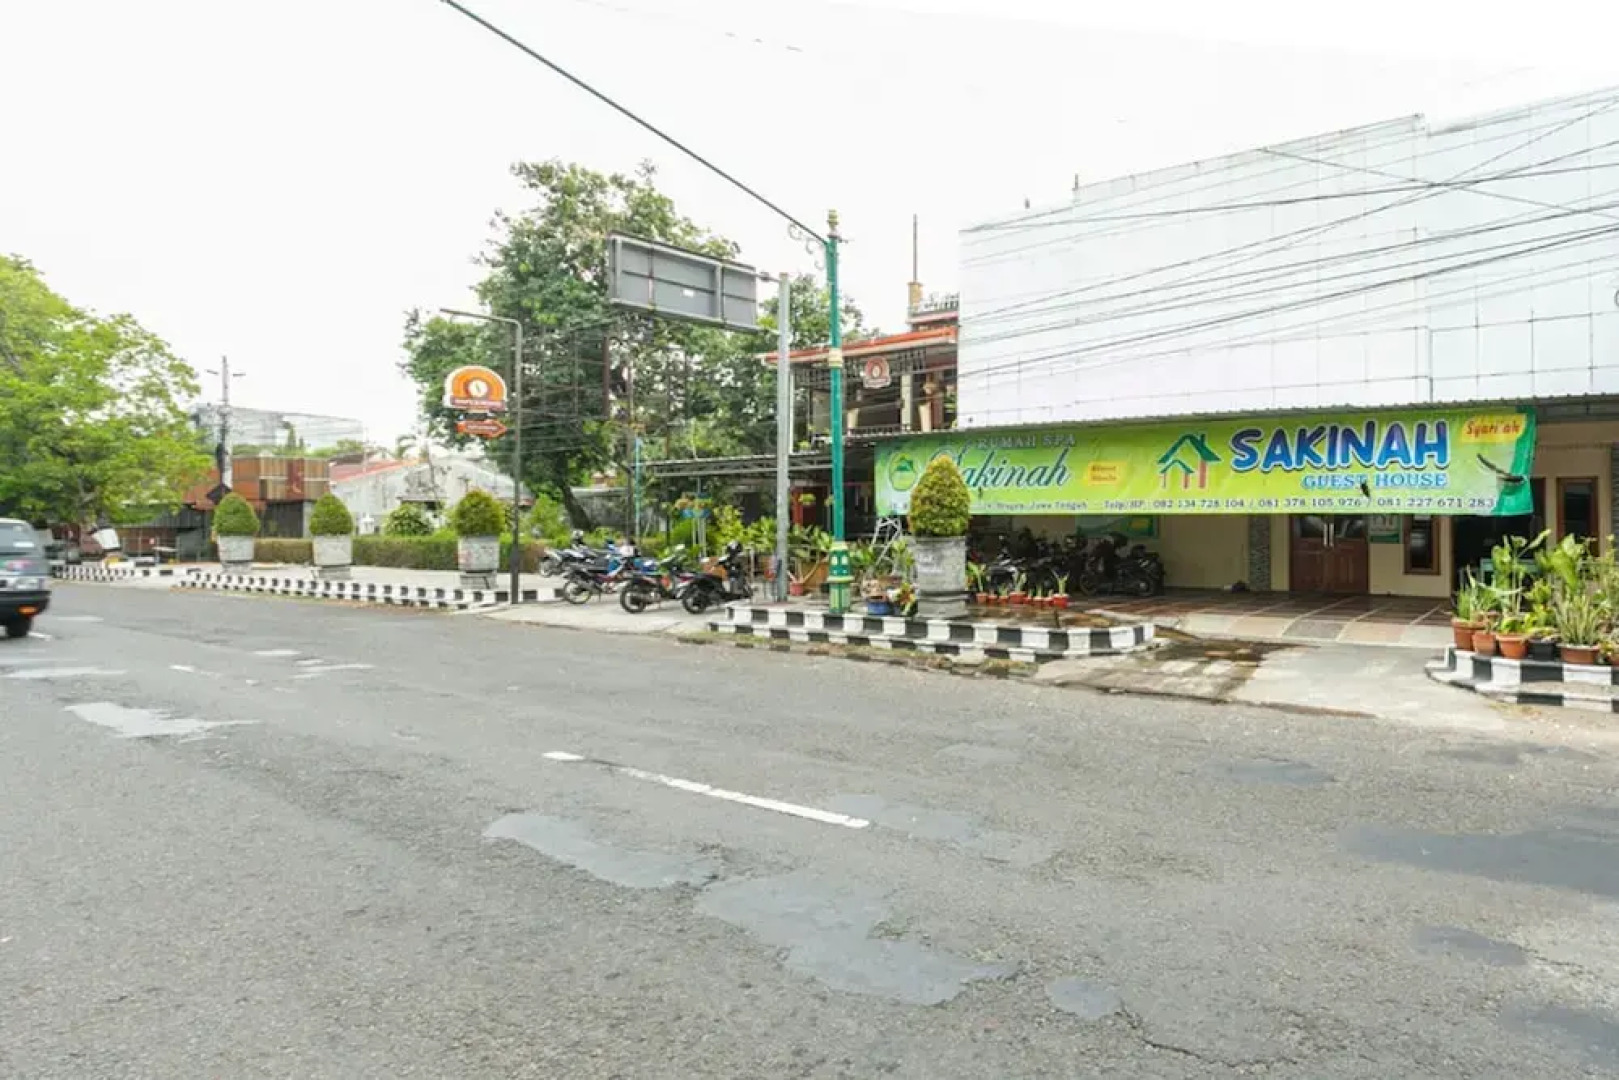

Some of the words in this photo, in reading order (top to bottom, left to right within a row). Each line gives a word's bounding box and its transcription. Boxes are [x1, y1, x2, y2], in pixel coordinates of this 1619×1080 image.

[978, 434, 1036, 449] RUMAH
[1042, 433, 1075, 448] SPA
[1230, 420, 1449, 471] SAKINAH
[1302, 473, 1367, 489] GUEST
[1374, 471, 1448, 488] HOUSE
[1377, 498, 1401, 506] 081
[1407, 498, 1432, 507] 227
[1437, 498, 1463, 507] 671
[1469, 498, 1495, 507] 283
